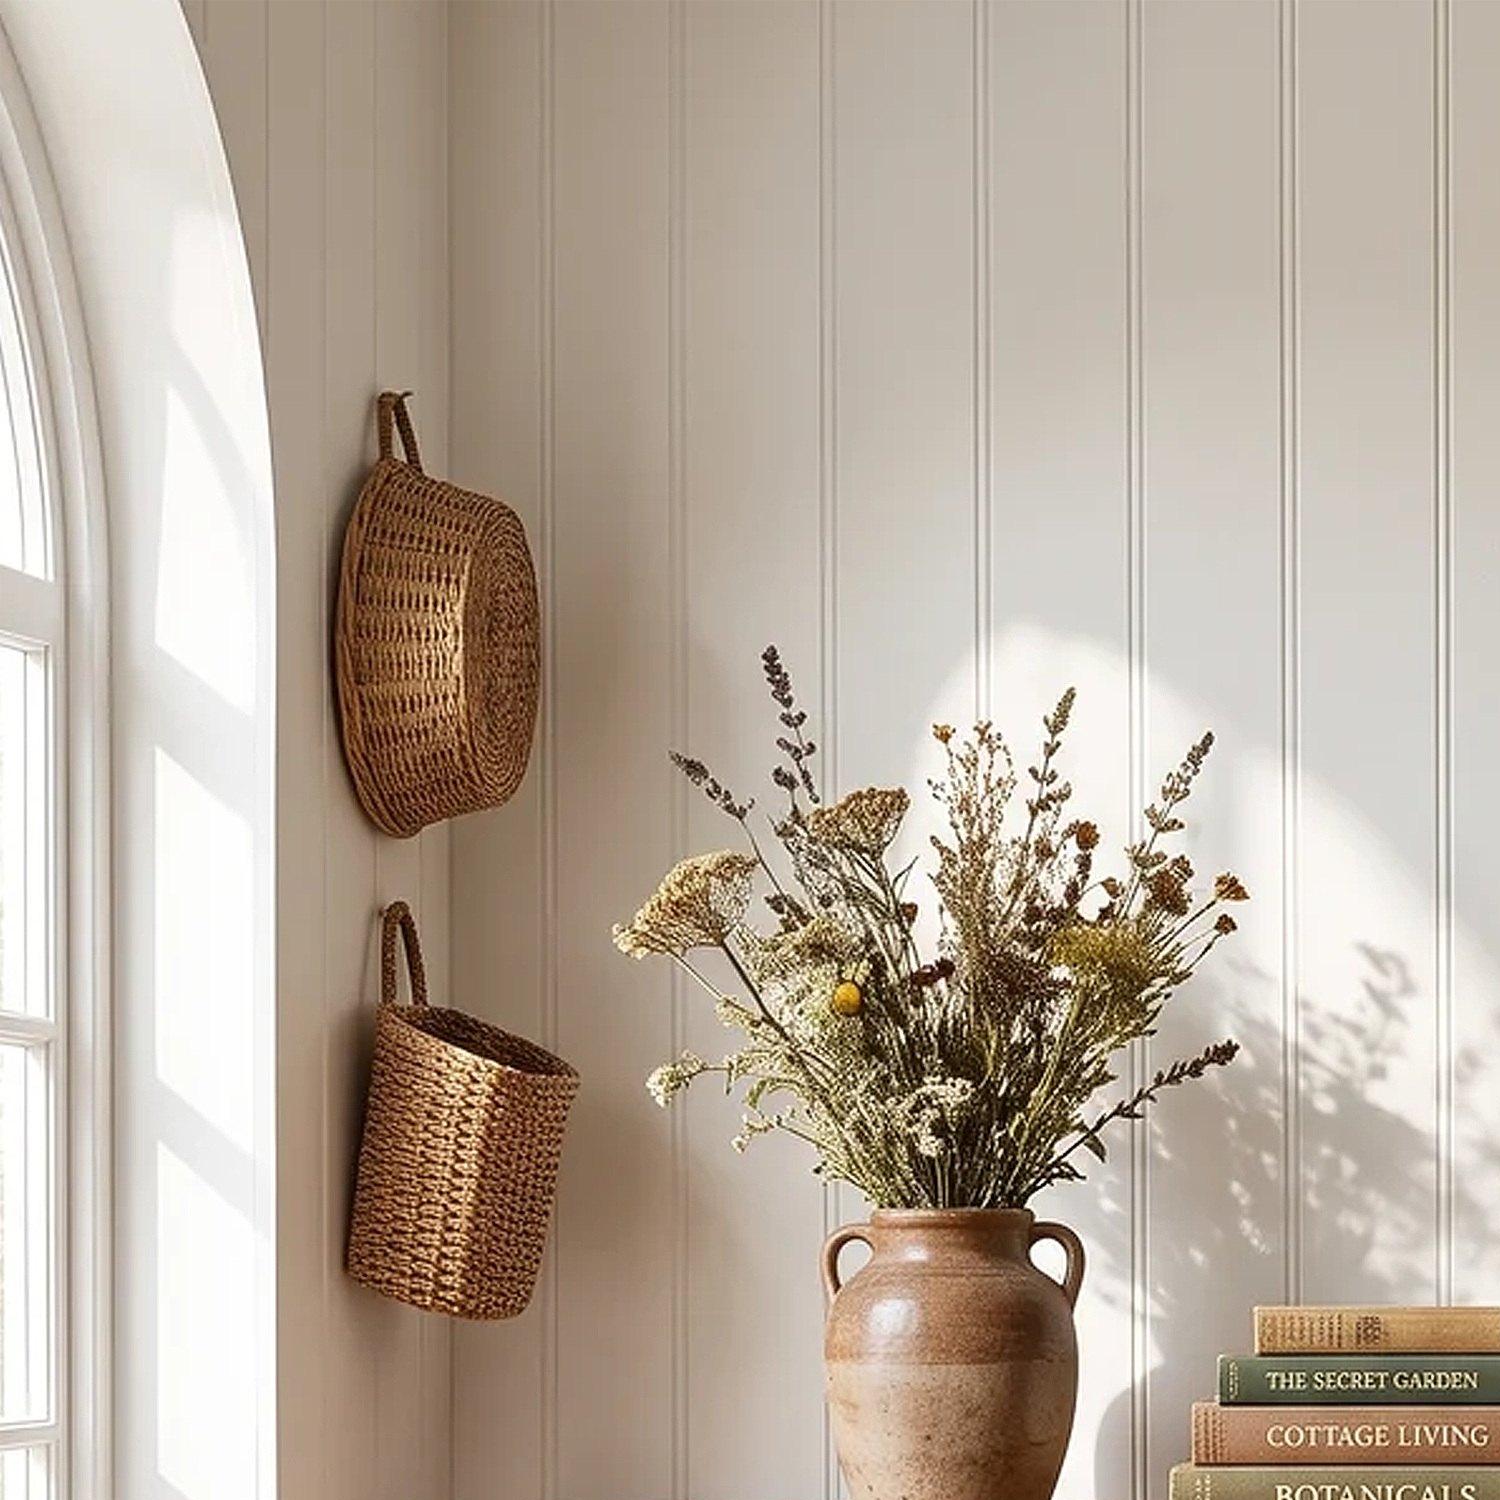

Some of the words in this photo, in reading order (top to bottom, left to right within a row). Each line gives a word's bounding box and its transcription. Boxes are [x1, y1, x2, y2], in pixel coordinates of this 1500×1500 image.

[1266, 1371, 1306, 1389] THE
[1314, 1370, 1390, 1390] SECRET
[1394, 1371, 1478, 1389] GARDEN
[1266, 1424, 1389, 1447] COTTAGE
[1398, 1424, 1488, 1447] LIVING
